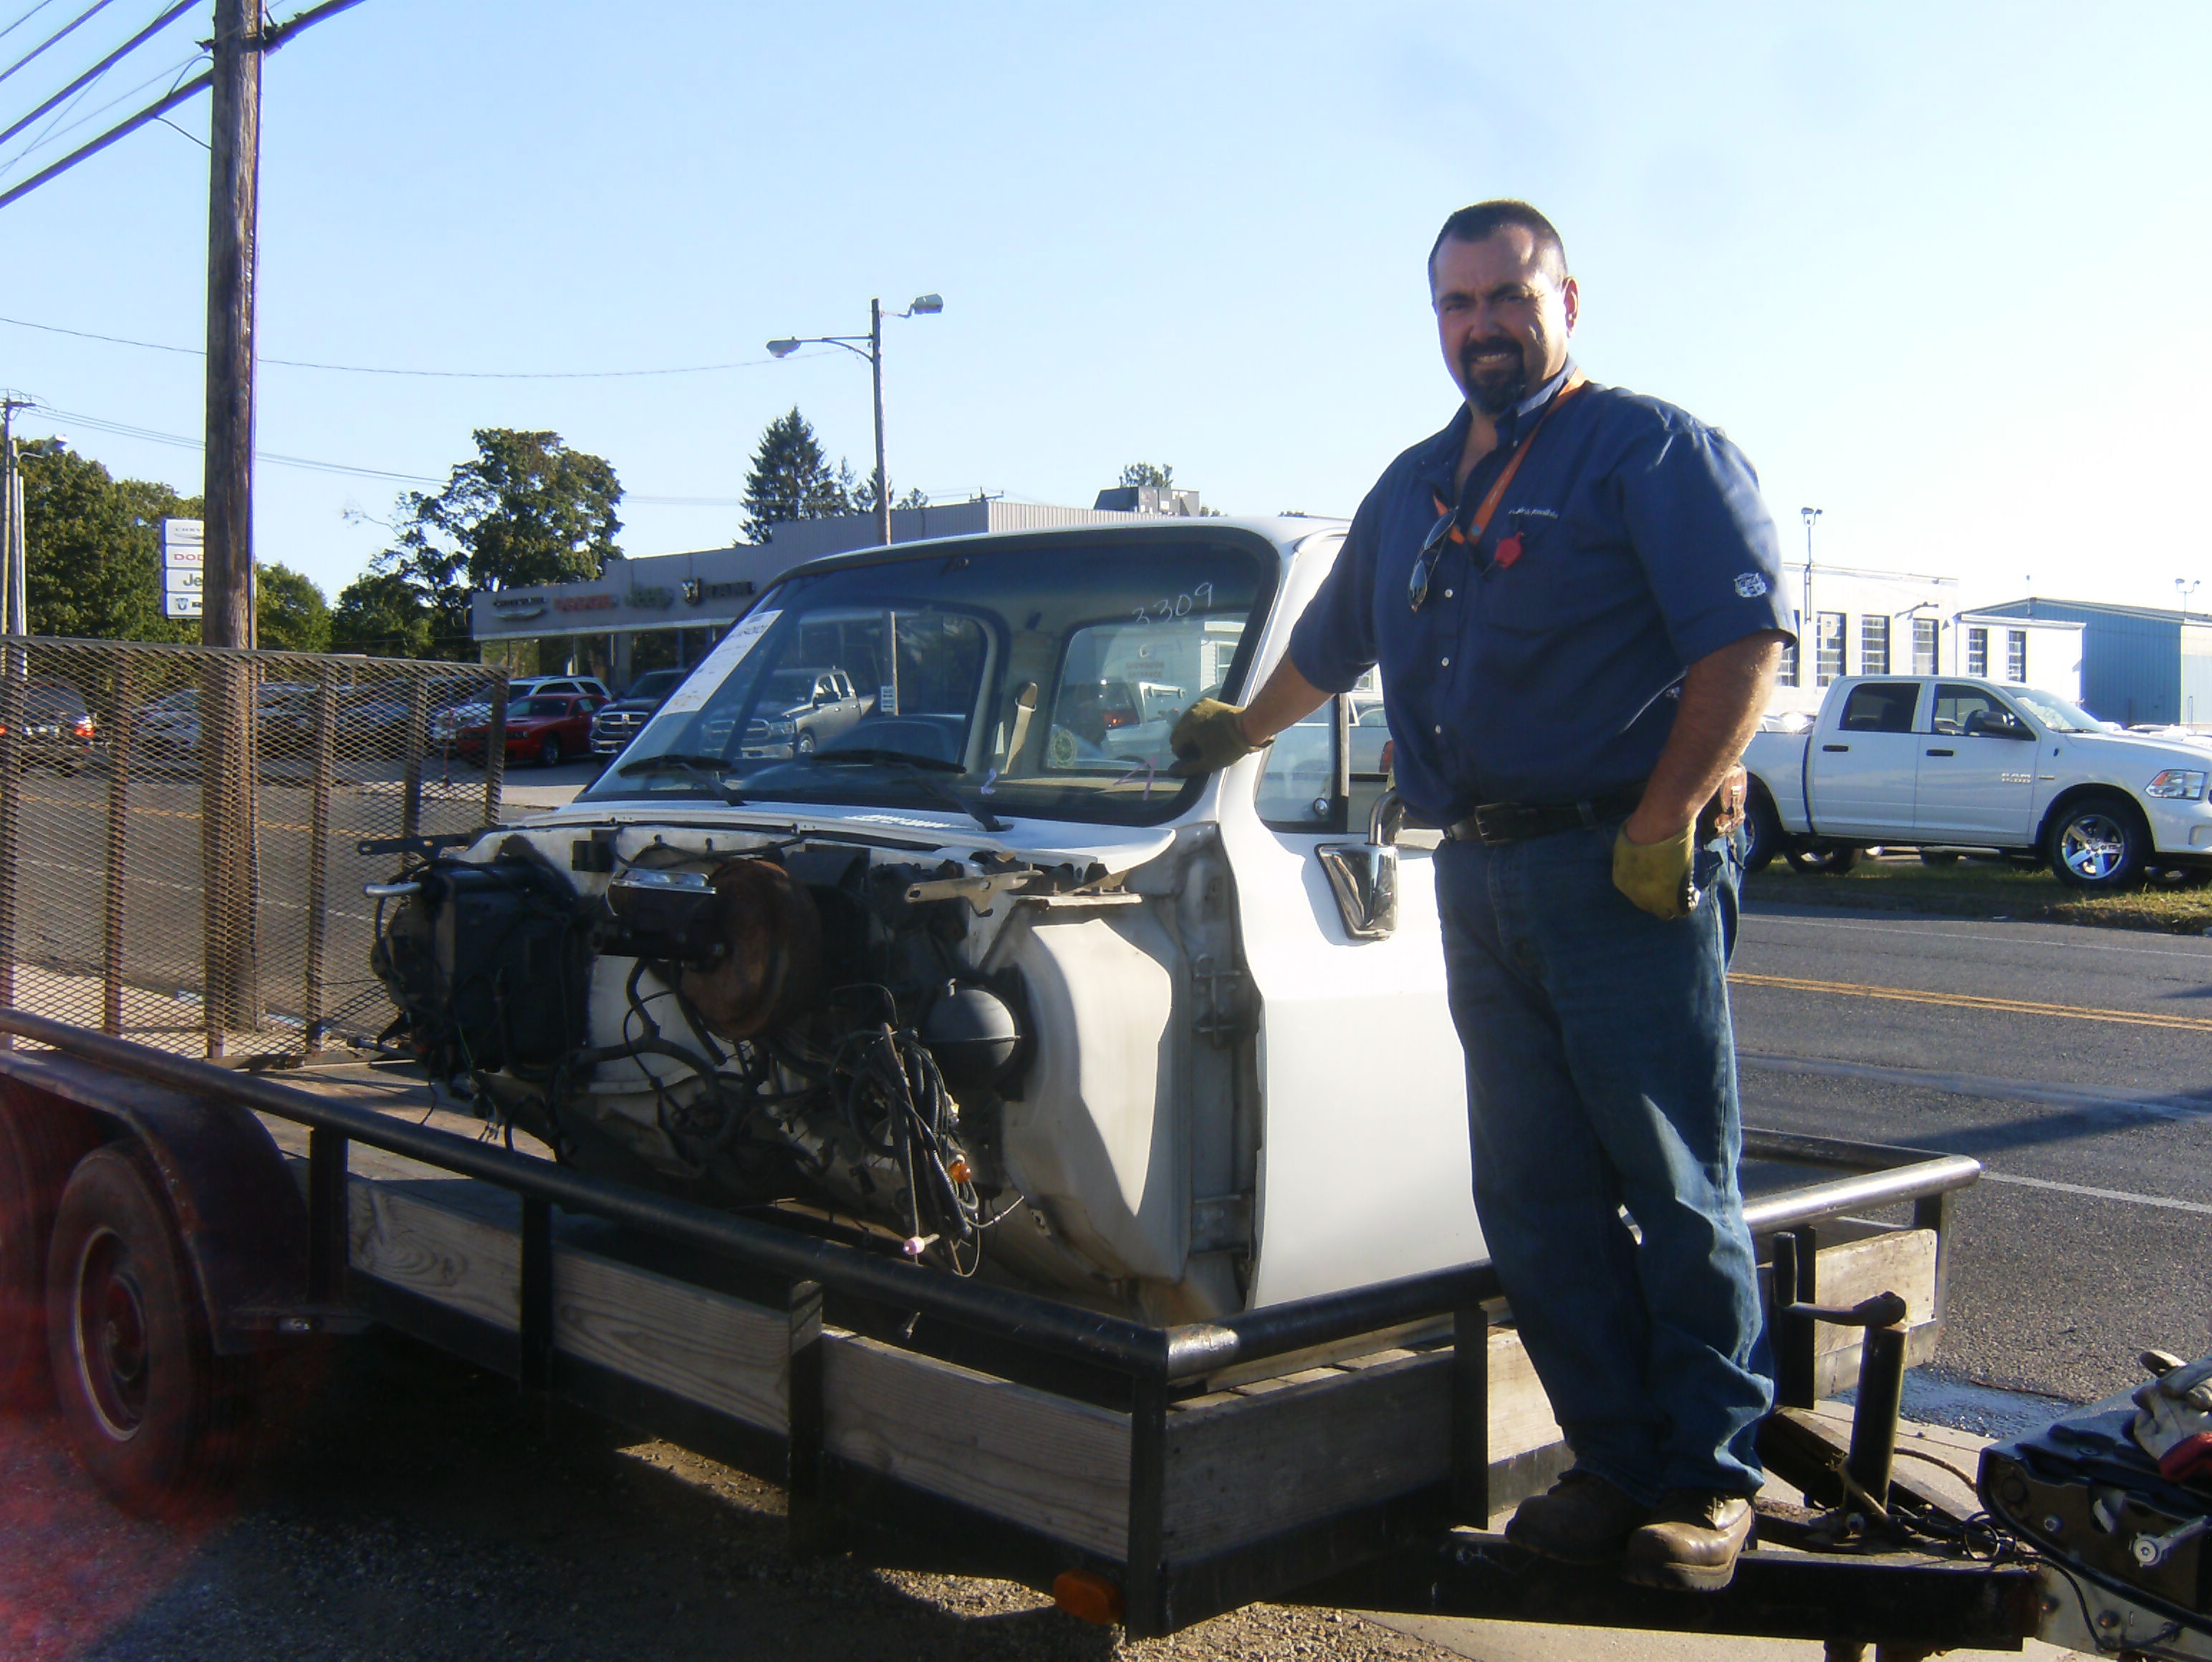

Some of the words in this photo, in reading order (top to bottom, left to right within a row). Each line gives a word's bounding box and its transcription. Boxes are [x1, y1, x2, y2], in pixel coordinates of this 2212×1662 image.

[183, 573, 203, 587] Je
[554, 594, 616, 611] DODGE
[1132, 582, 1213, 625] 3309
